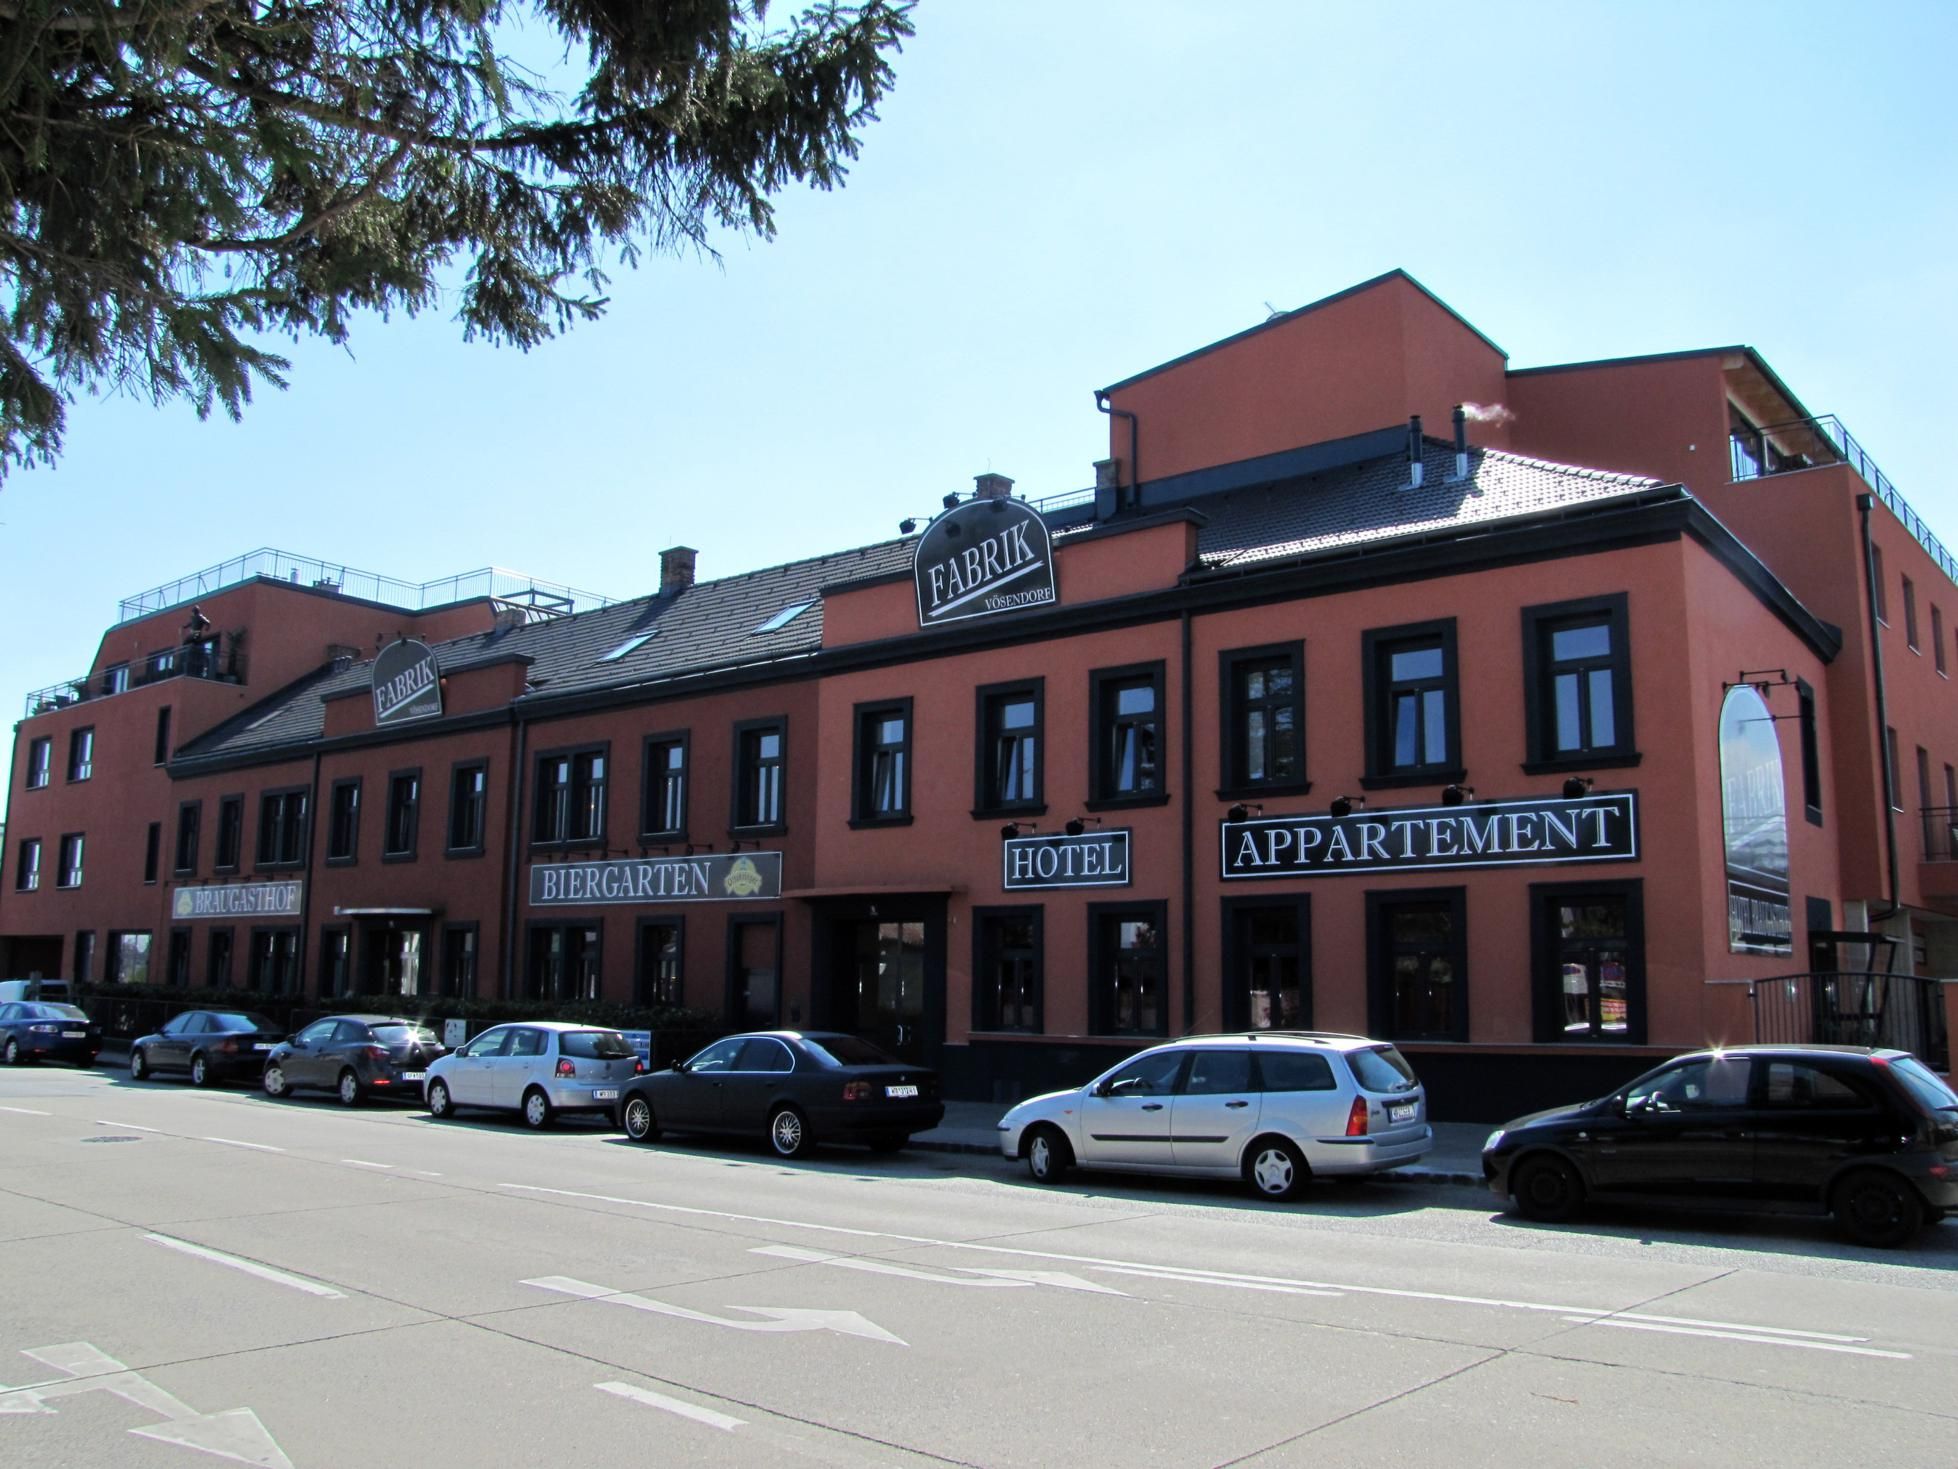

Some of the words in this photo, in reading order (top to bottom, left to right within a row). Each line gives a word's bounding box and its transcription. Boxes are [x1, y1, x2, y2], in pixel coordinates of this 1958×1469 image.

[927, 519, 1035, 608] FABRIK
[985, 587, 1051, 610] VÖSENDORF
[376, 655, 434, 713] FABRIK
[1233, 806, 1619, 867] APPARTEMENT
[1011, 842, 1122, 879] HOTEL
[195, 885, 296, 914] BRAUGASTHOF
[541, 862, 712, 900] BIERGARTEN
